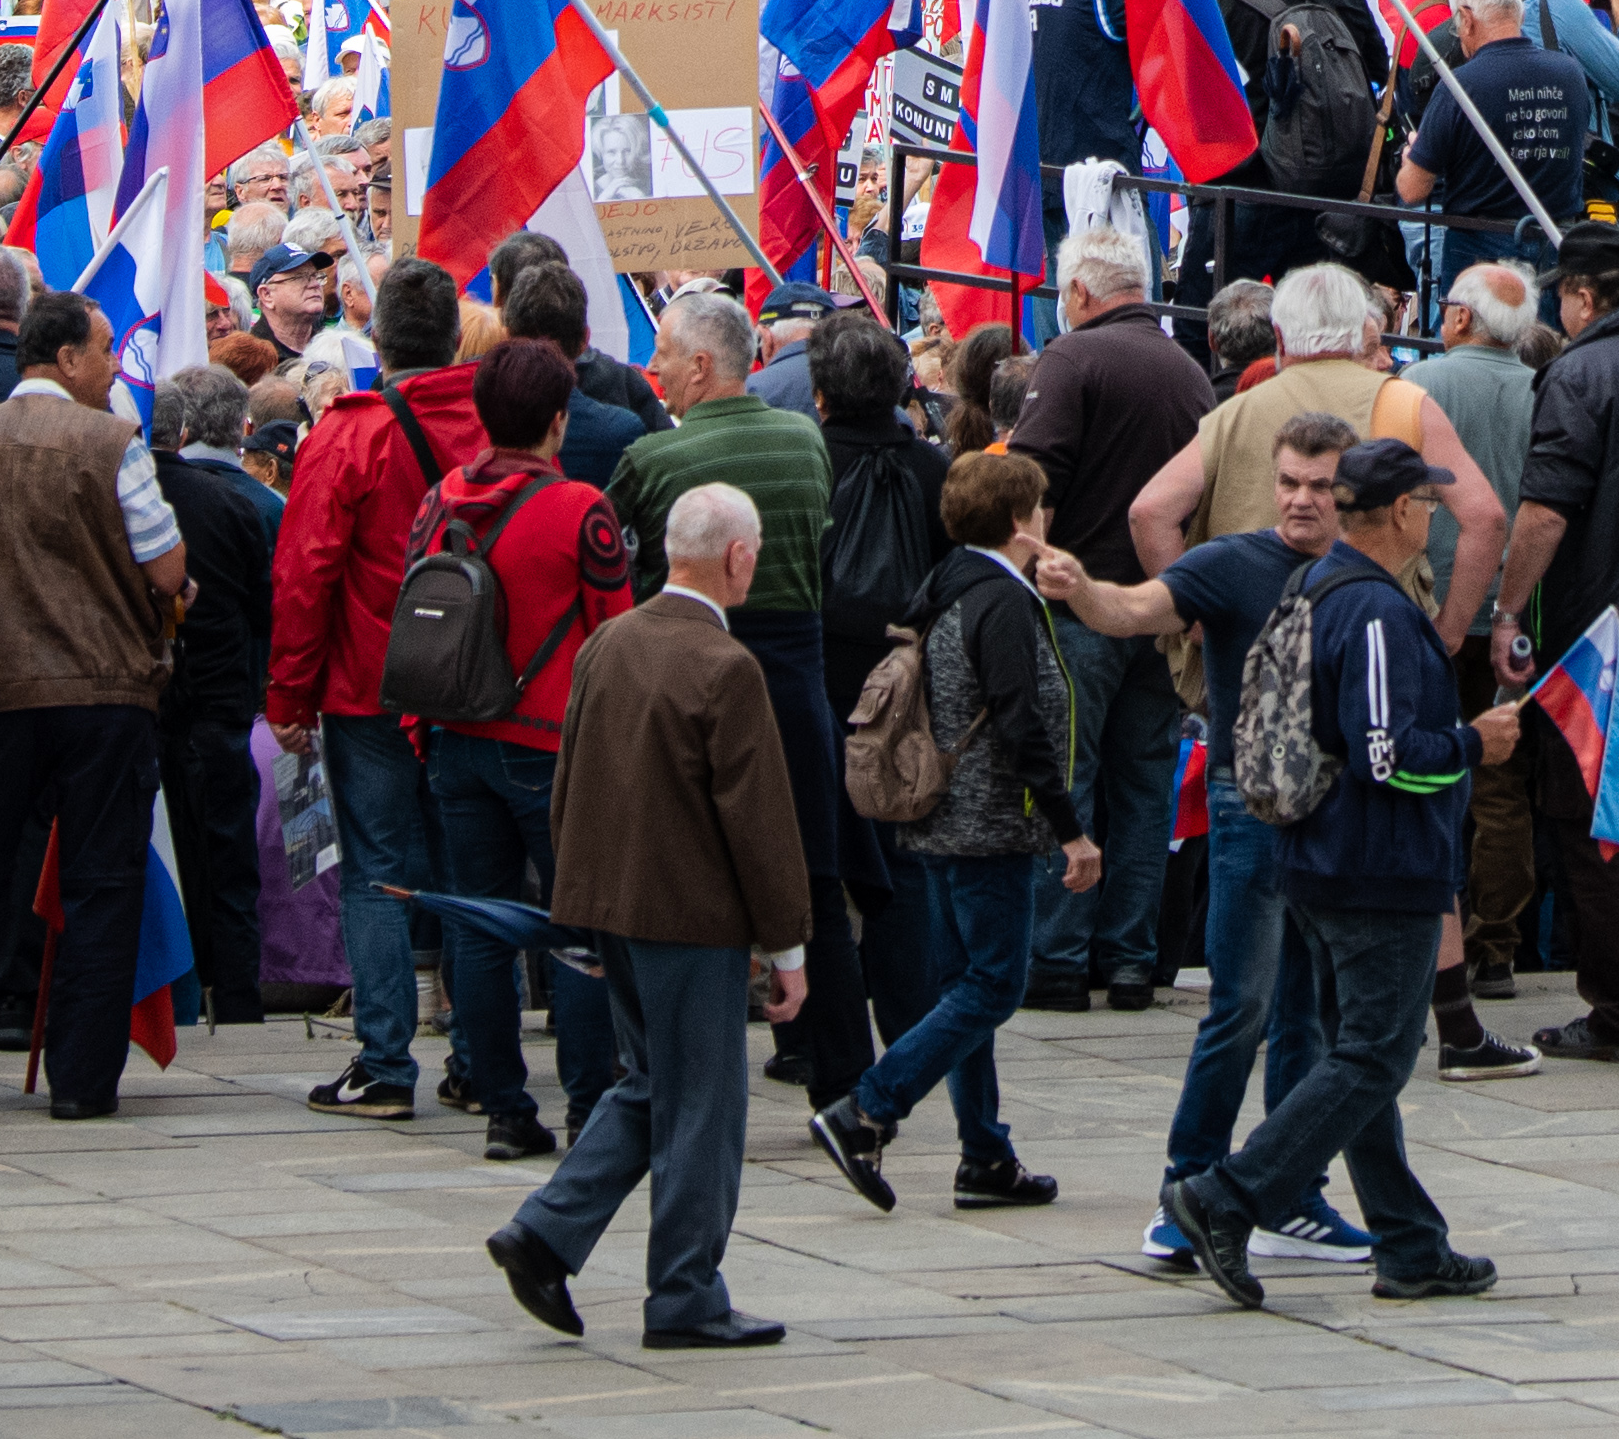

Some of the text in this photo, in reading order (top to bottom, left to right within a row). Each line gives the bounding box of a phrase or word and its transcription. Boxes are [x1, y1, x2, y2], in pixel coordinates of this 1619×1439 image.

[1508, 86, 1563, 102] Meni nihče
[895, 99, 954, 143] KOMUNI
[1505, 106, 1568, 122] ne bo govoril
[606, 225, 668, 243] ASTNINO,
